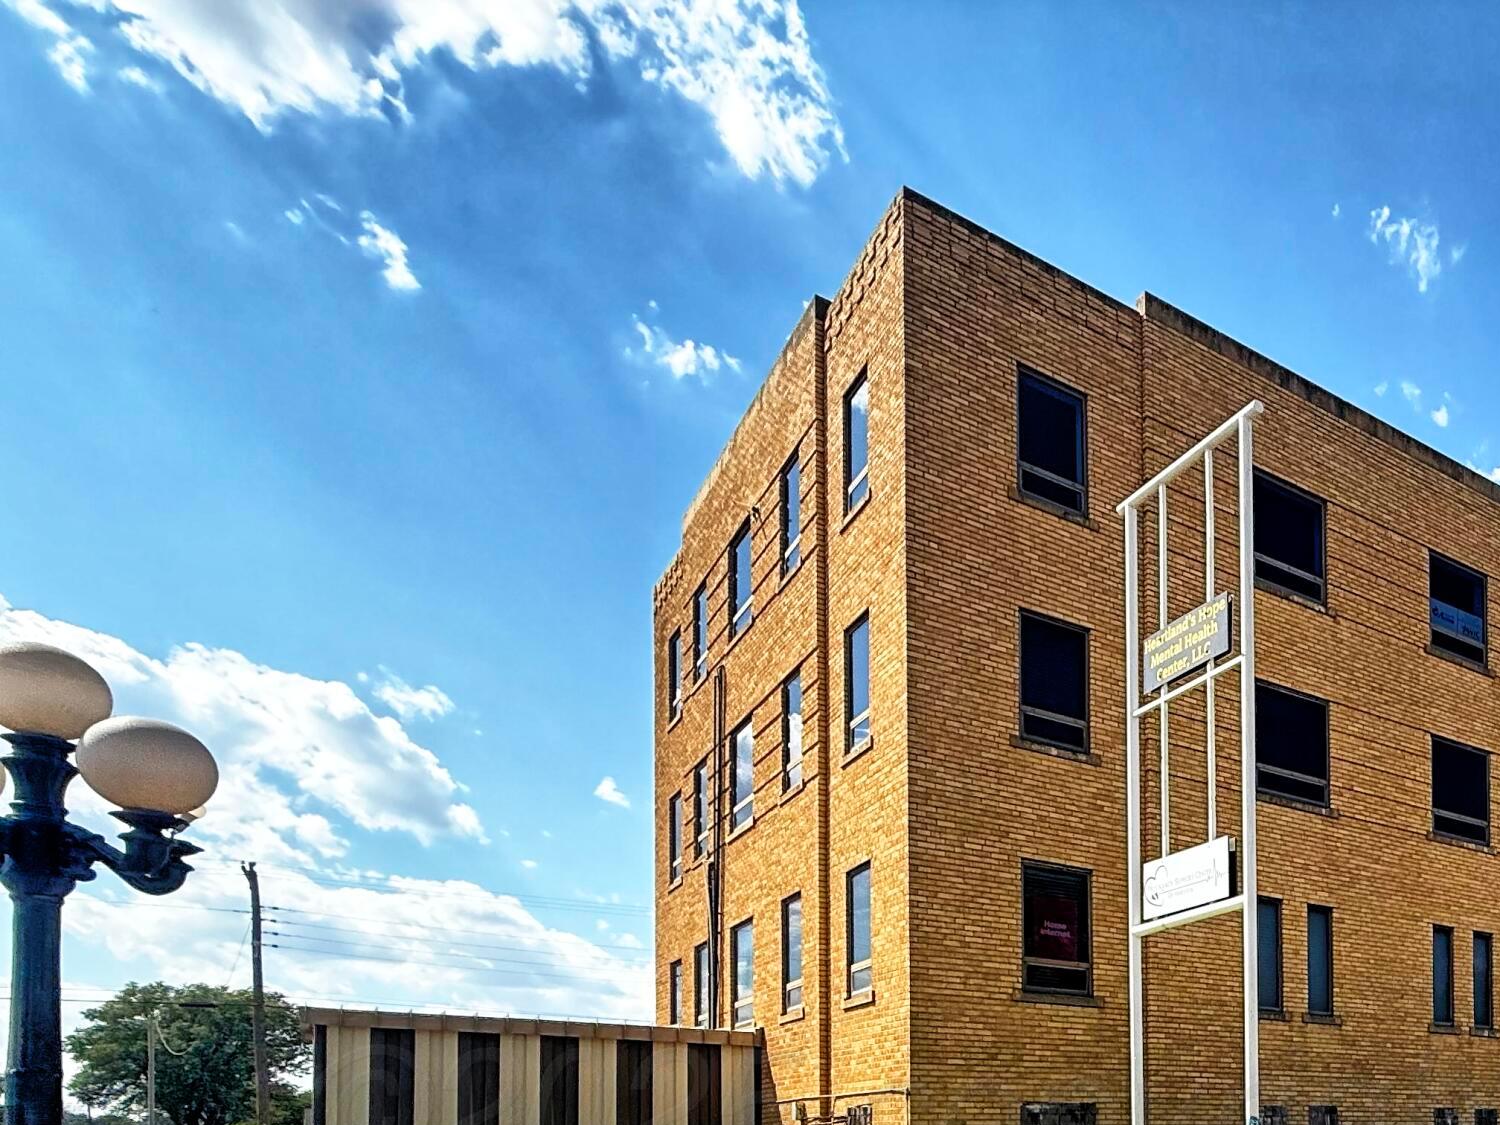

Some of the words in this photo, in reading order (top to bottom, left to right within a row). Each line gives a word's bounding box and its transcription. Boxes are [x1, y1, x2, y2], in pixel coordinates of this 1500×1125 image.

[1143, 613, 1196, 654] Heartland's
[1198, 598, 1226, 622] Hope
[1150, 638, 1183, 669] Mental
[1184, 621, 1218, 649] Health
[1156, 656, 1190, 682] Center,
[1191, 641, 1211, 661] LLC
